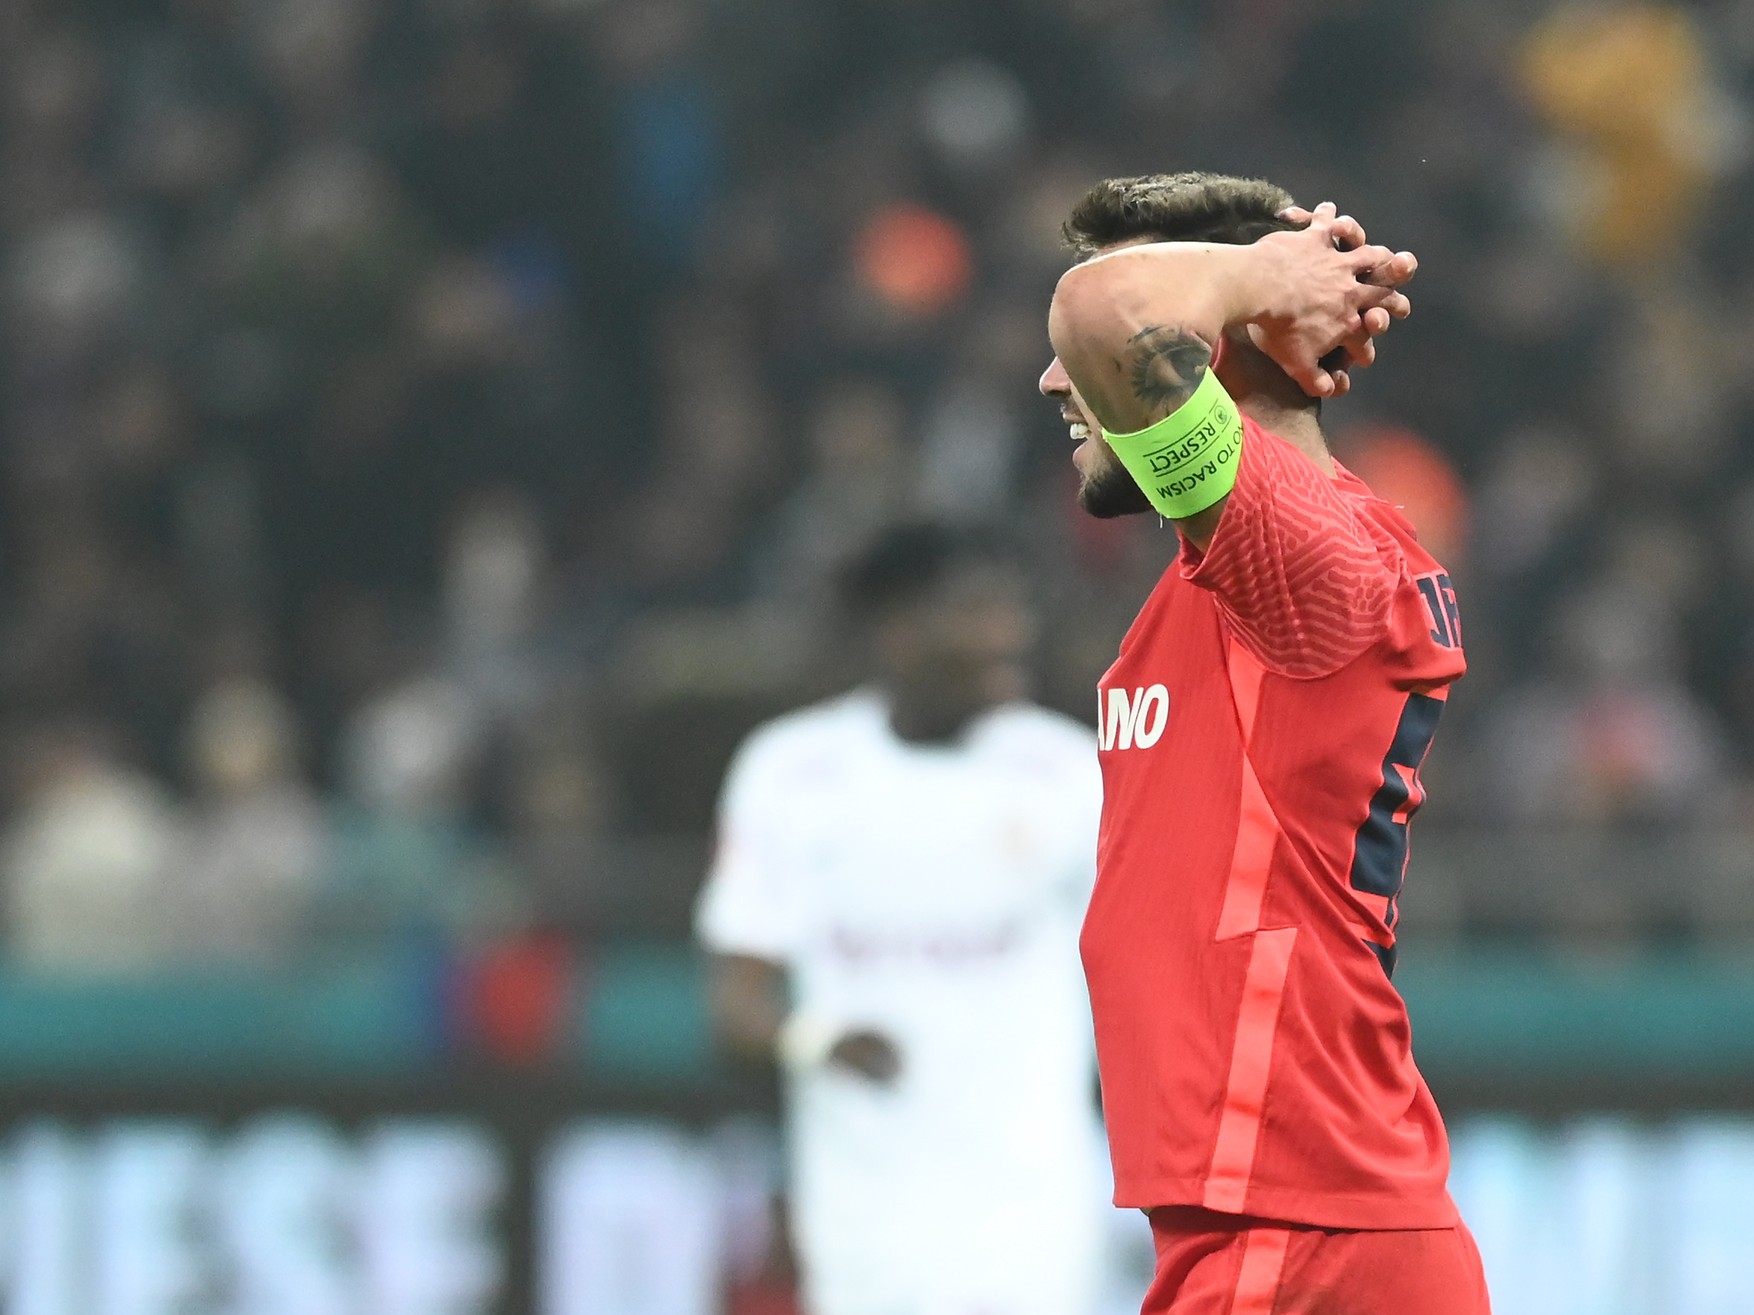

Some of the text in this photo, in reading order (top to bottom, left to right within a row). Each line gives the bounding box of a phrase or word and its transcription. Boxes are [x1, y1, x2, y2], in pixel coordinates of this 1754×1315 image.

[1149, 422, 1216, 473] RESPECT
[1217, 443, 1235, 465] TO
[1156, 461, 1218, 499] RACISM
